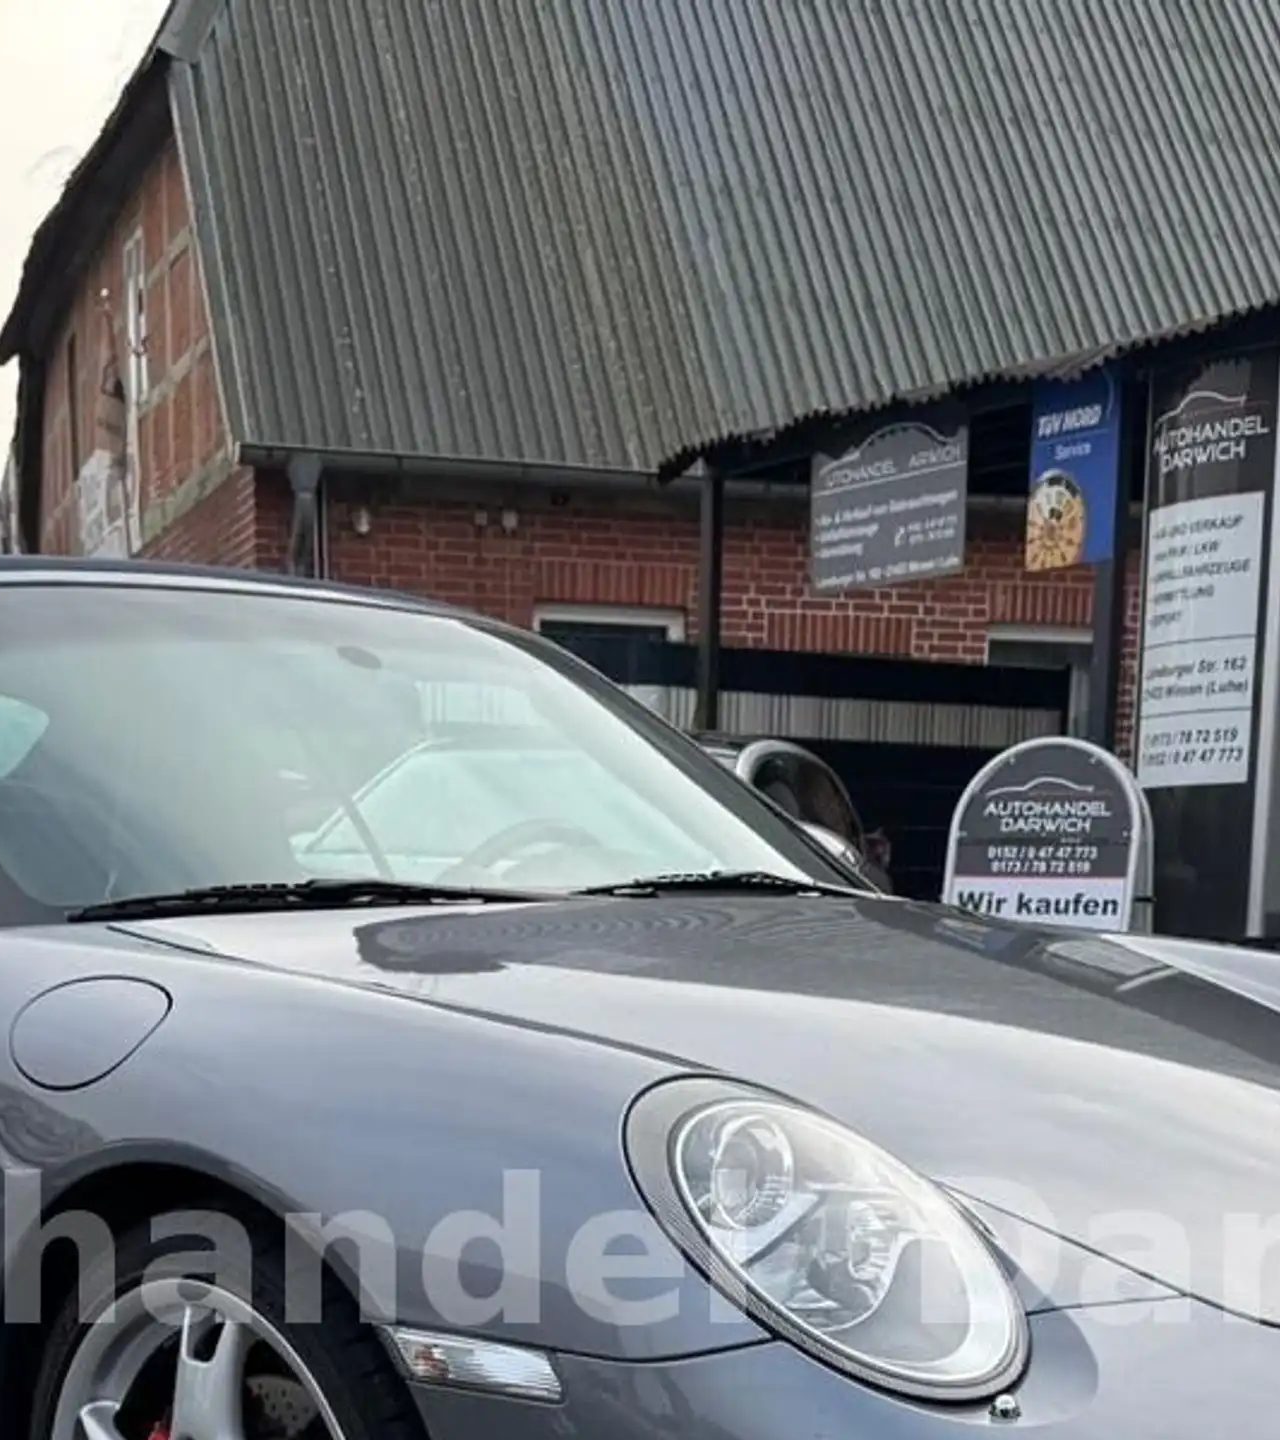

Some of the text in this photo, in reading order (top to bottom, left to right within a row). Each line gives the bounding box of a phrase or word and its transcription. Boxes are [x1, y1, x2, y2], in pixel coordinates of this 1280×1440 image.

[1152, 415, 1270, 456] AUTOHANDEL
[1160, 438, 1246, 475] DARWICH
[1218, 747, 1244, 762] 773
[983, 800, 1113, 818] AUTOHANDEL
[999, 816, 1092, 834] DARWICH
[1055, 846, 1071, 859] 47
[1074, 846, 1098, 860] 773
[957, 890, 1120, 916] Wir kaufen
